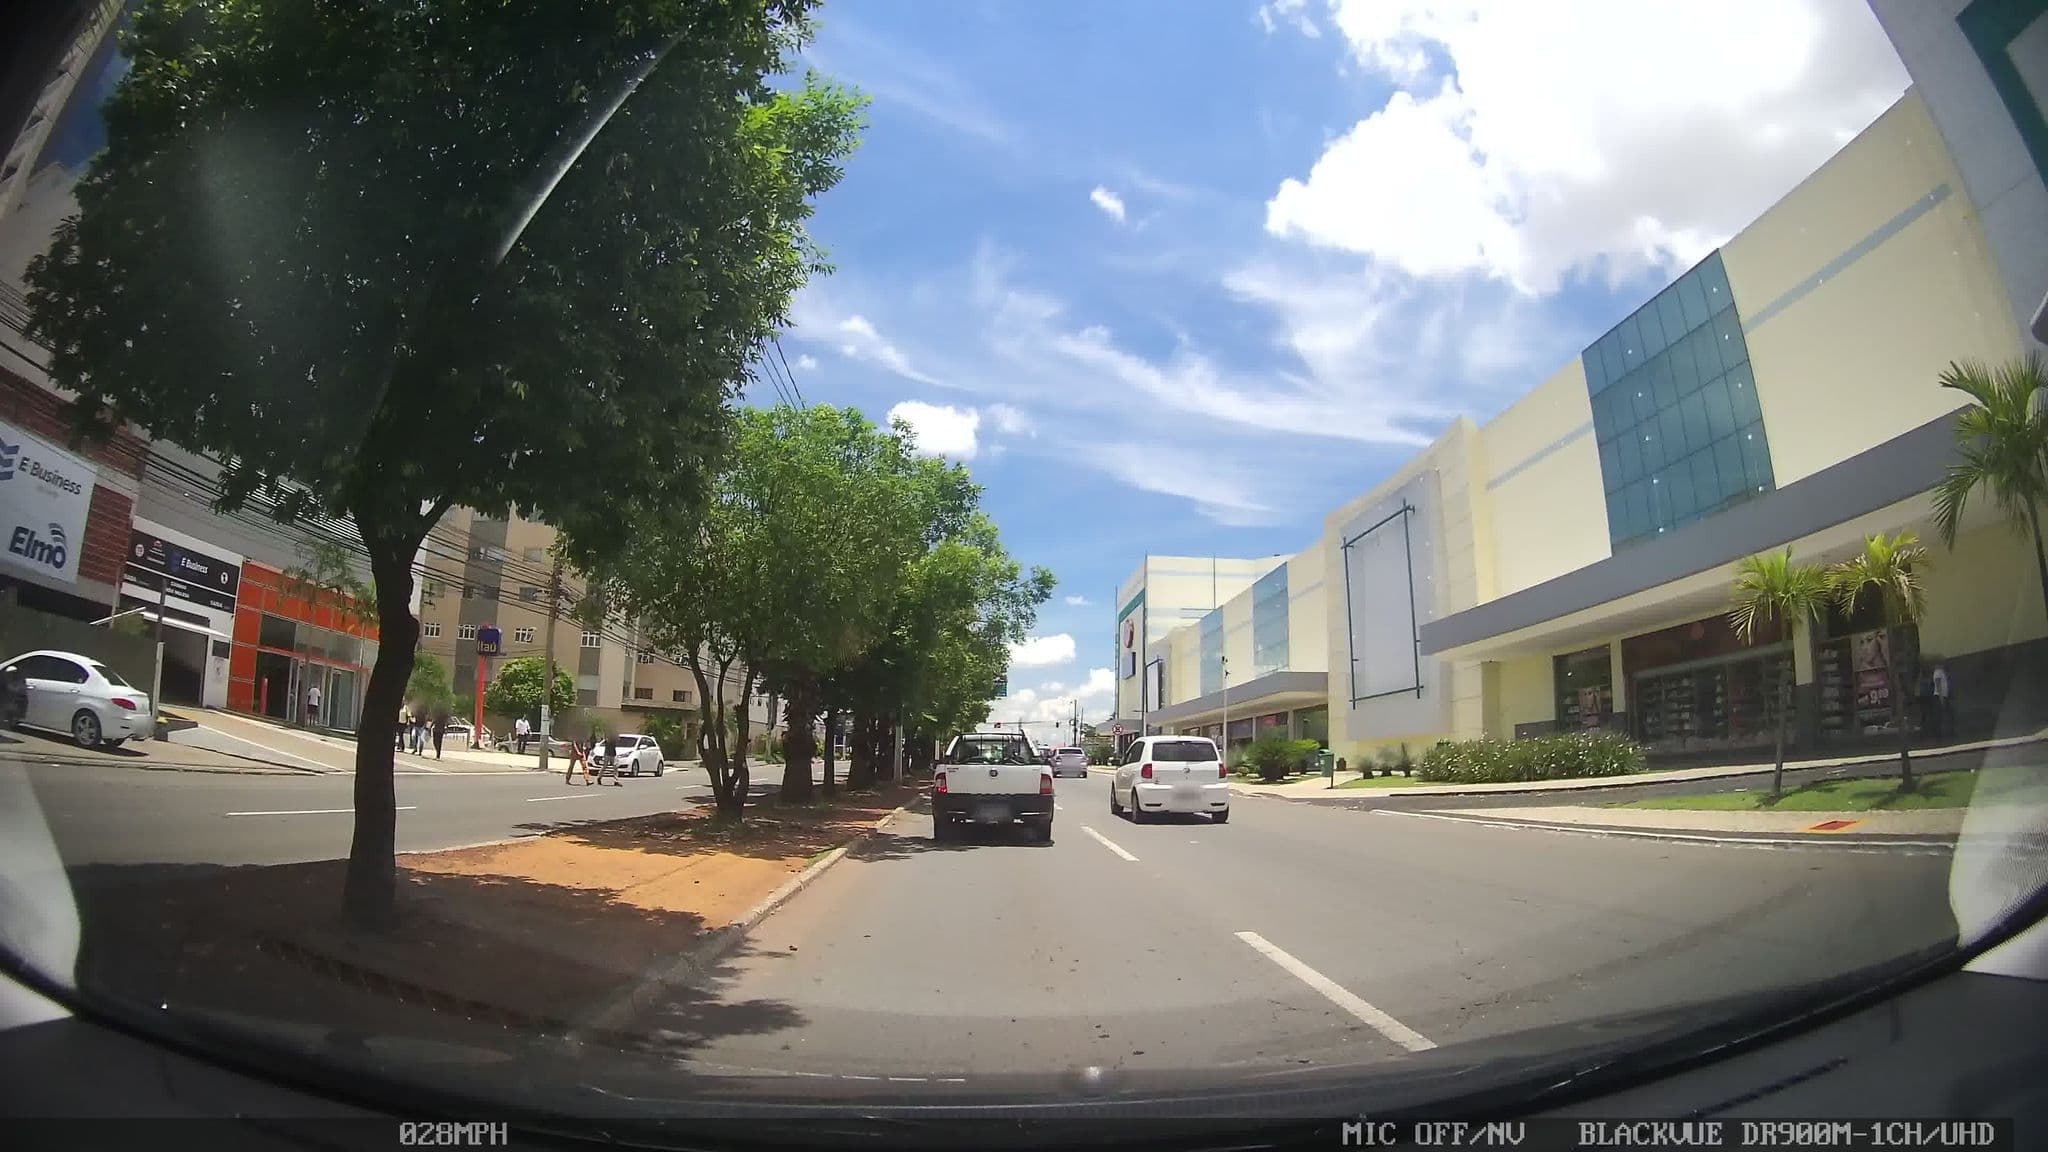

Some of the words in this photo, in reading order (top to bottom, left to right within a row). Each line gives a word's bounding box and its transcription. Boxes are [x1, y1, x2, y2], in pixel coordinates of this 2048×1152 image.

[19, 456, 30, 472] E
[30, 462, 82, 495] Business
[9, 526, 66, 569] Elmo
